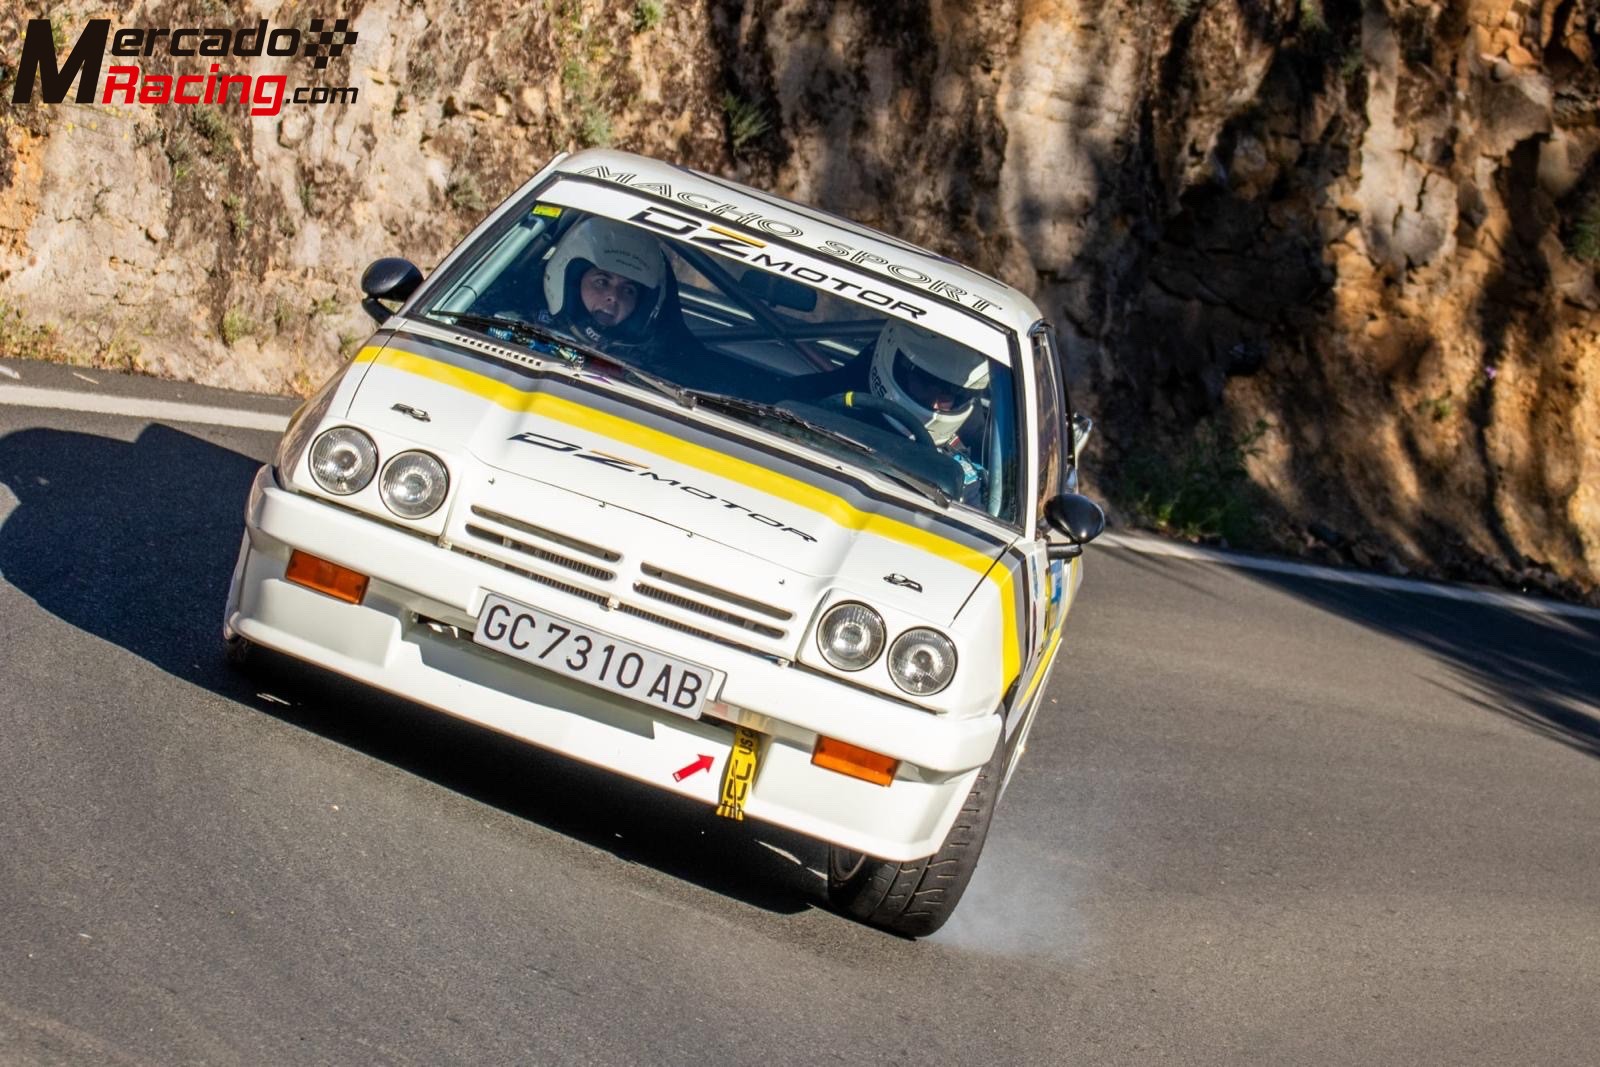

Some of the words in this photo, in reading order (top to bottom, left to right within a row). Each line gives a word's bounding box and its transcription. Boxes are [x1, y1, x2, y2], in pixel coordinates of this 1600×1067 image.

[577, 165, 803, 238] MACHO
[817, 240, 1003, 313] SPORT
[483, 604, 536, 650] GC
[538, 622, 644, 689] 7310
[647, 664, 702, 710] AB
